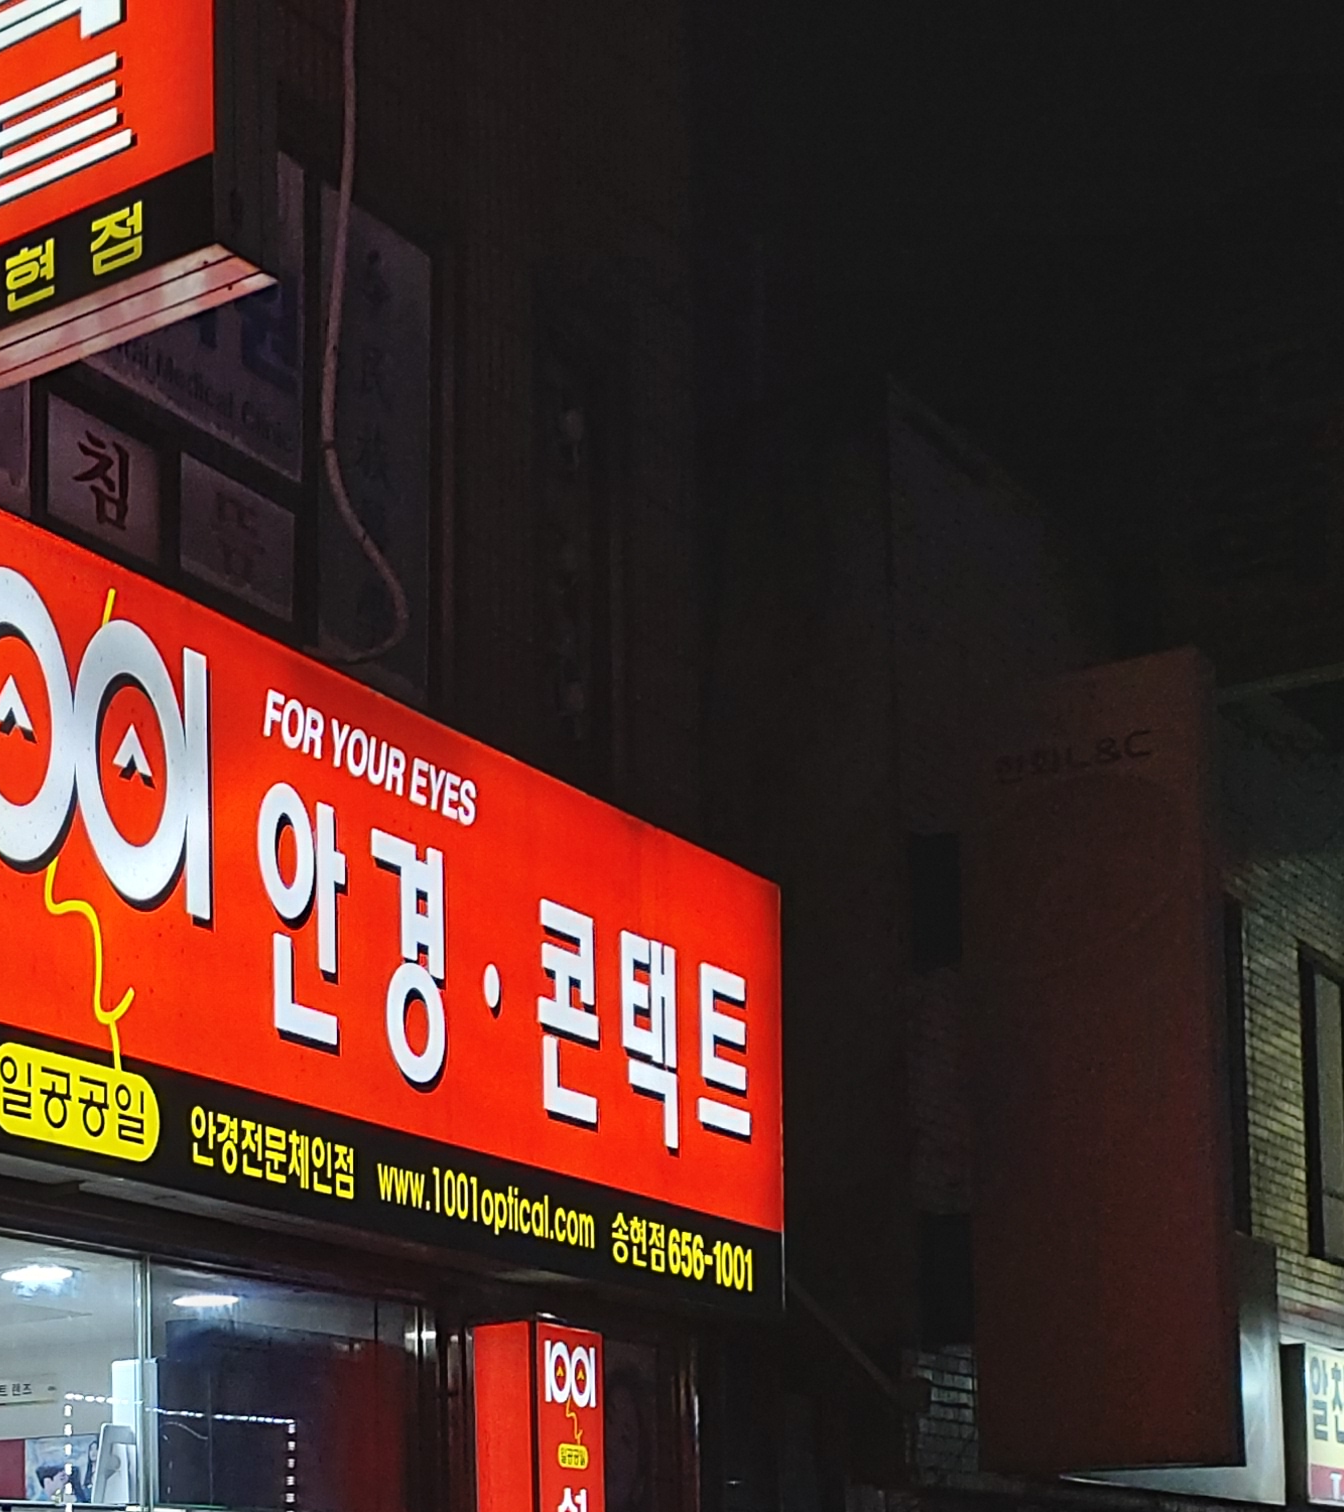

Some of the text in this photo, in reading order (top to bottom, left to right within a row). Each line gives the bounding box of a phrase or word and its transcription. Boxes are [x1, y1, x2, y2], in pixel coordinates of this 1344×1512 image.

[73, 429, 130, 531] 침
[262, 687, 476, 828] FOR YOUR EYES
[191, 1106, 752, 1292] 안경전문체인점 www.1001optical.com 송현점 656-1001
[544, 1339, 597, 1408] 1001
